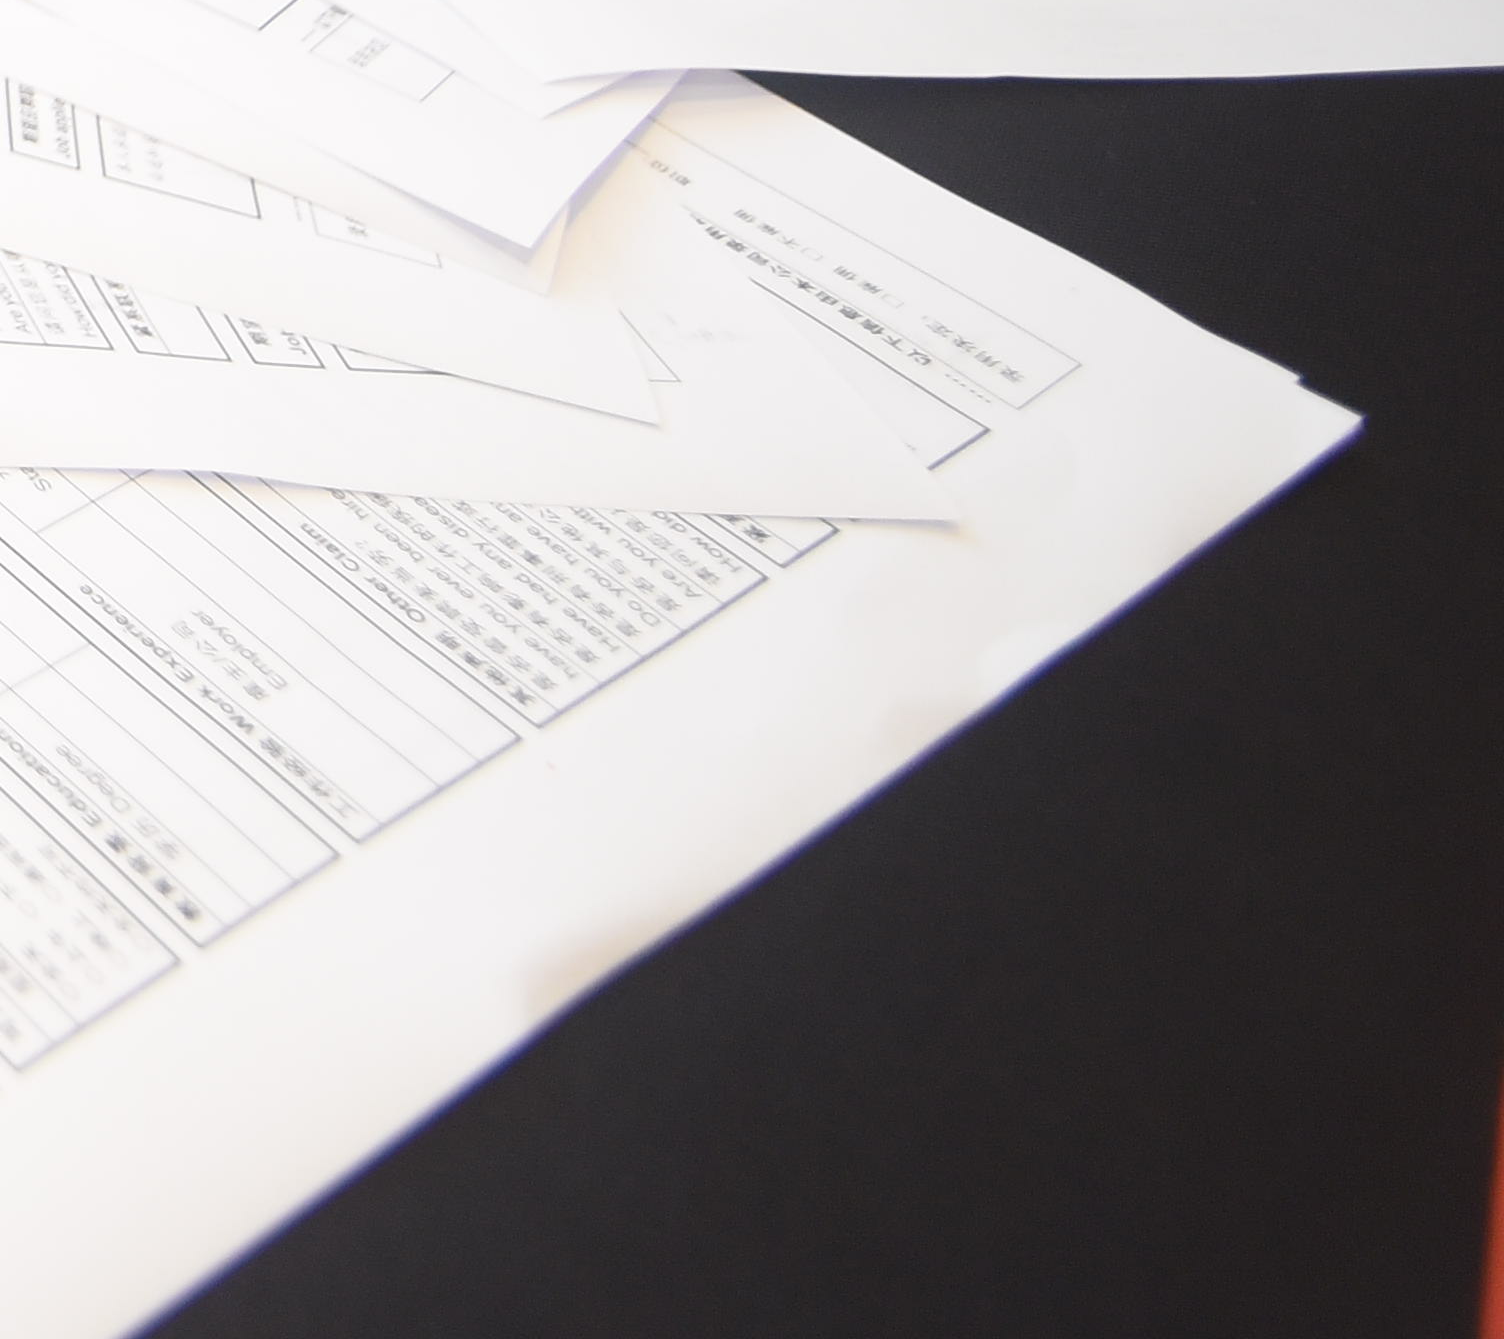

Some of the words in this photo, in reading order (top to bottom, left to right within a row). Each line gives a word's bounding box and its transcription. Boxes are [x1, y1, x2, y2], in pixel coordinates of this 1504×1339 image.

[8, 309, 33, 335] Are
[299, 522, 368, 573] Claim
[372, 521, 426, 564] been
[470, 539, 523, 571] any
[525, 524, 581, 566] have
[615, 537, 660, 569] you
[688, 536, 745, 574] How
[362, 576, 428, 626] Other
[425, 566, 476, 601] ever
[512, 572, 561, 606] had
[582, 566, 632, 599] you
[660, 568, 705, 599] Are
[79, 583, 197, 684] Experience
[478, 600, 528, 635] you
[561, 606, 622, 654] Have
[626, 599, 663, 628] Do
[189, 610, 290, 692] Employer
[523, 636, 580, 681] have
[196, 683, 257, 737] Work
[55, 743, 132, 815] Degree
